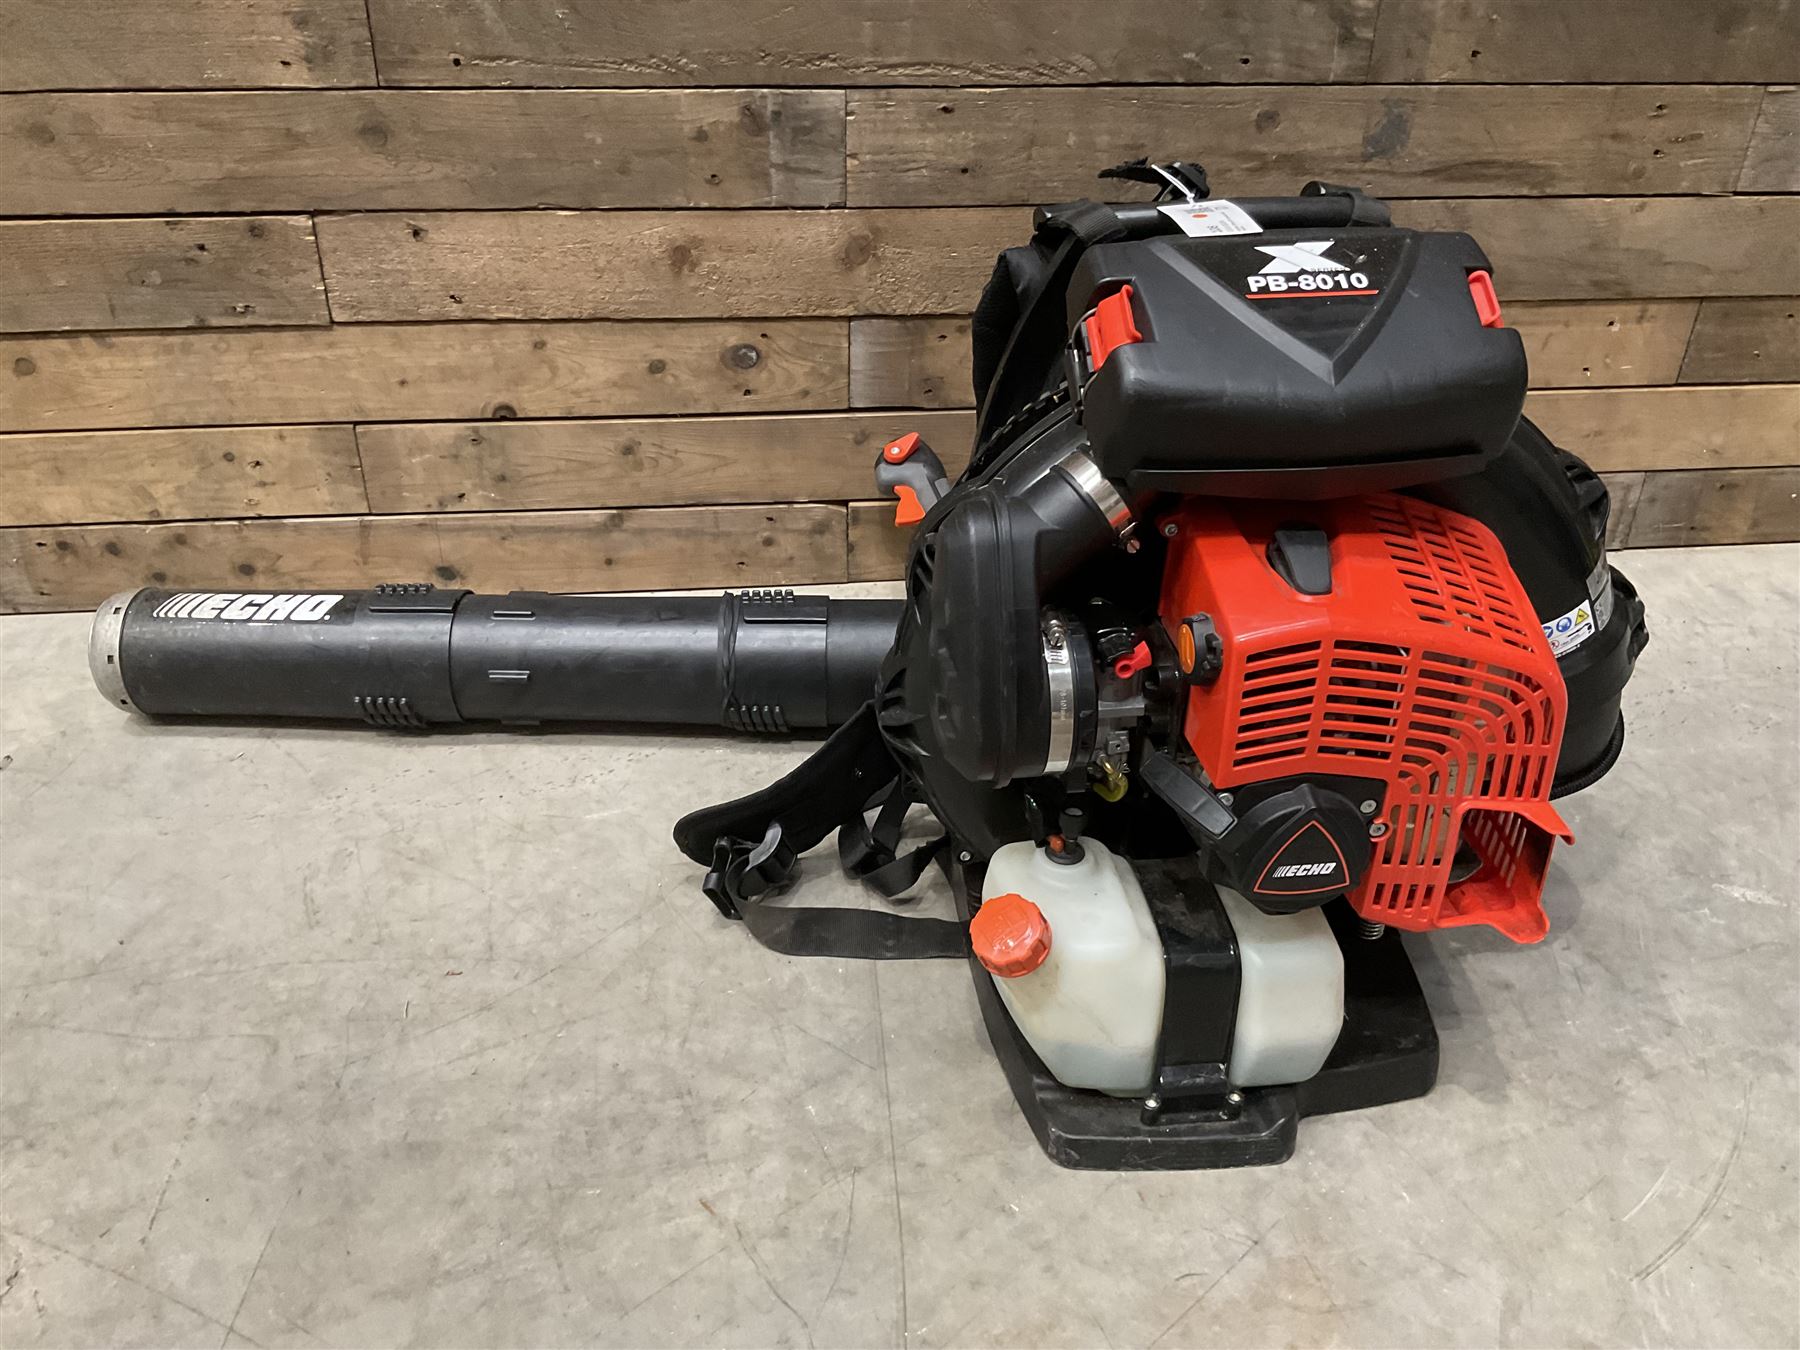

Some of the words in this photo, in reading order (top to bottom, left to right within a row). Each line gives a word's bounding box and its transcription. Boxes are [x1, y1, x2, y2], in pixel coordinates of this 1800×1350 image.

[1247, 272, 1368, 292] PB-8010
[191, 593, 344, 620] ECHO
[1286, 862, 1336, 877] ECHO
